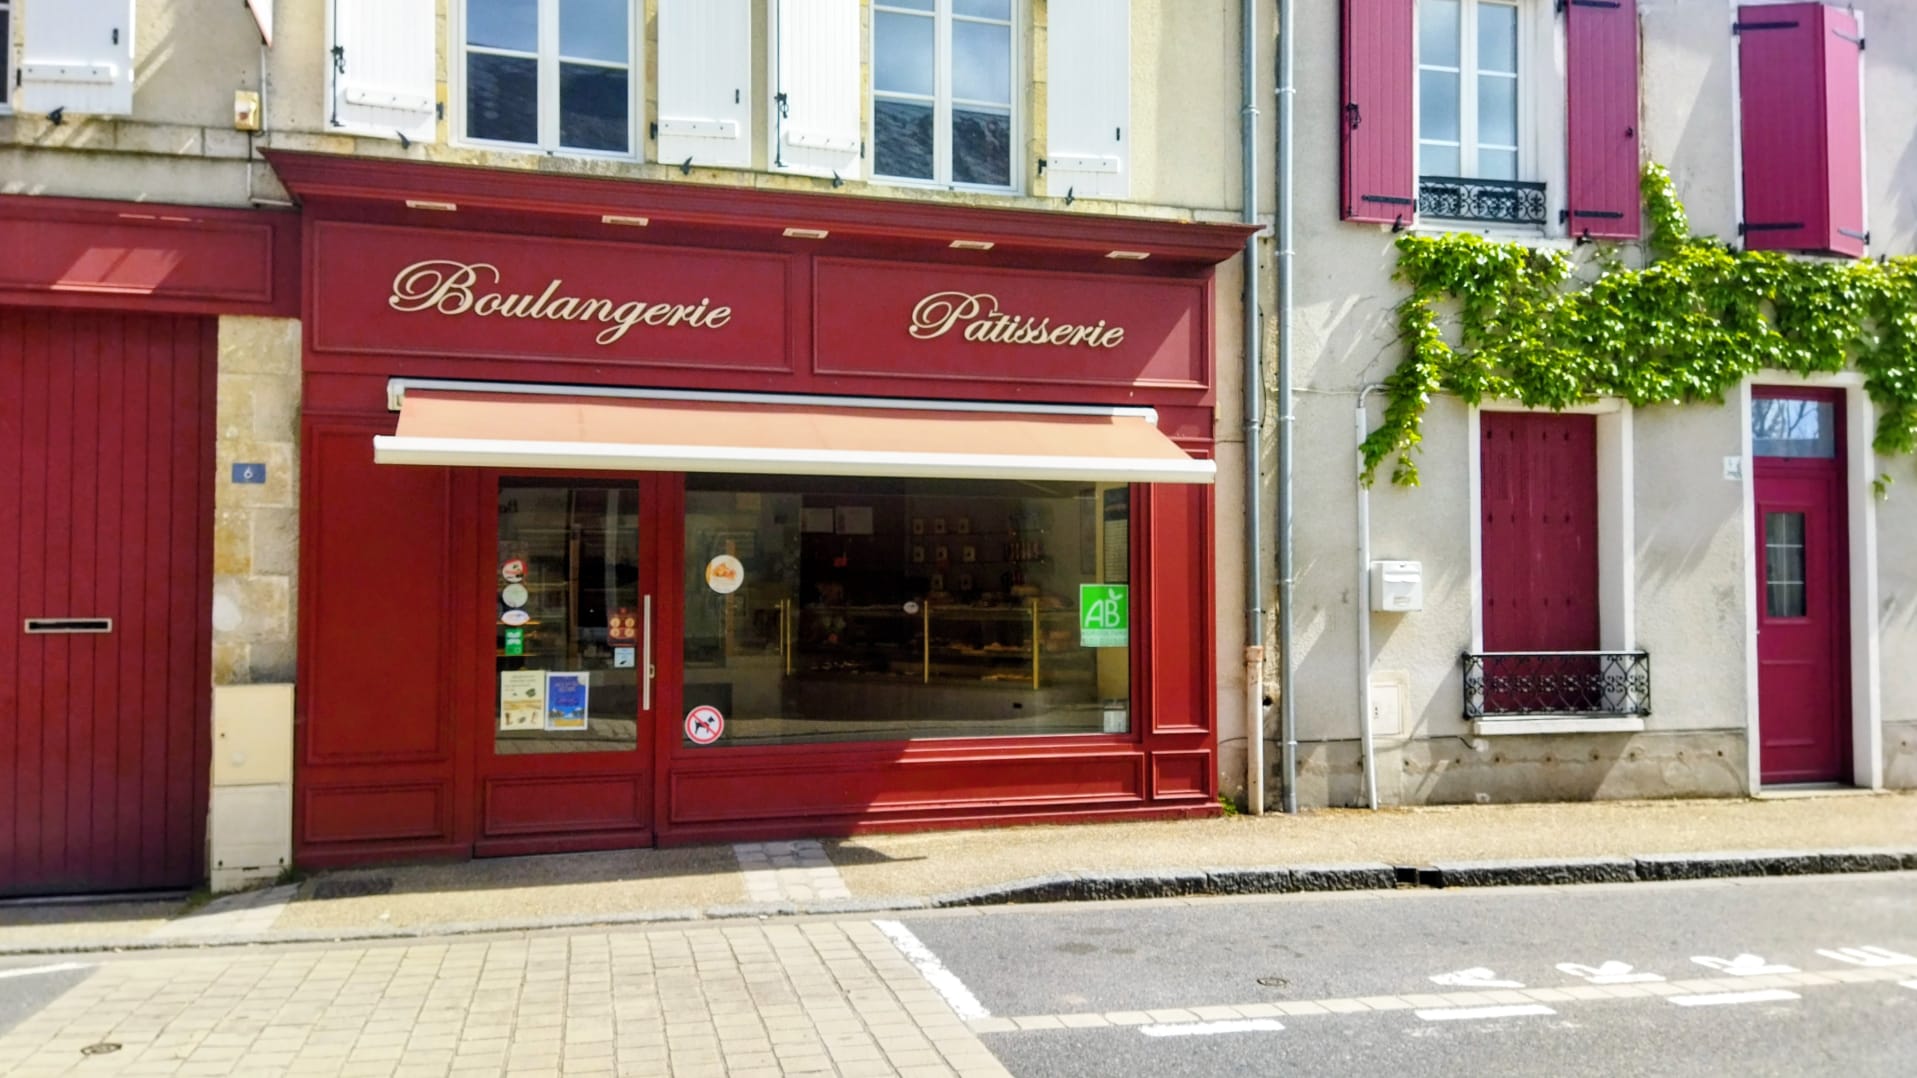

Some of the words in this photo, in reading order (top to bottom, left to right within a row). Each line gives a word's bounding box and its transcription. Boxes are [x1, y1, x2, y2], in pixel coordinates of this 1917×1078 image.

[389, 259, 732, 345] Boulangerie
[243, 465, 254, 480] 6
[1084, 598, 1121, 629] AB
